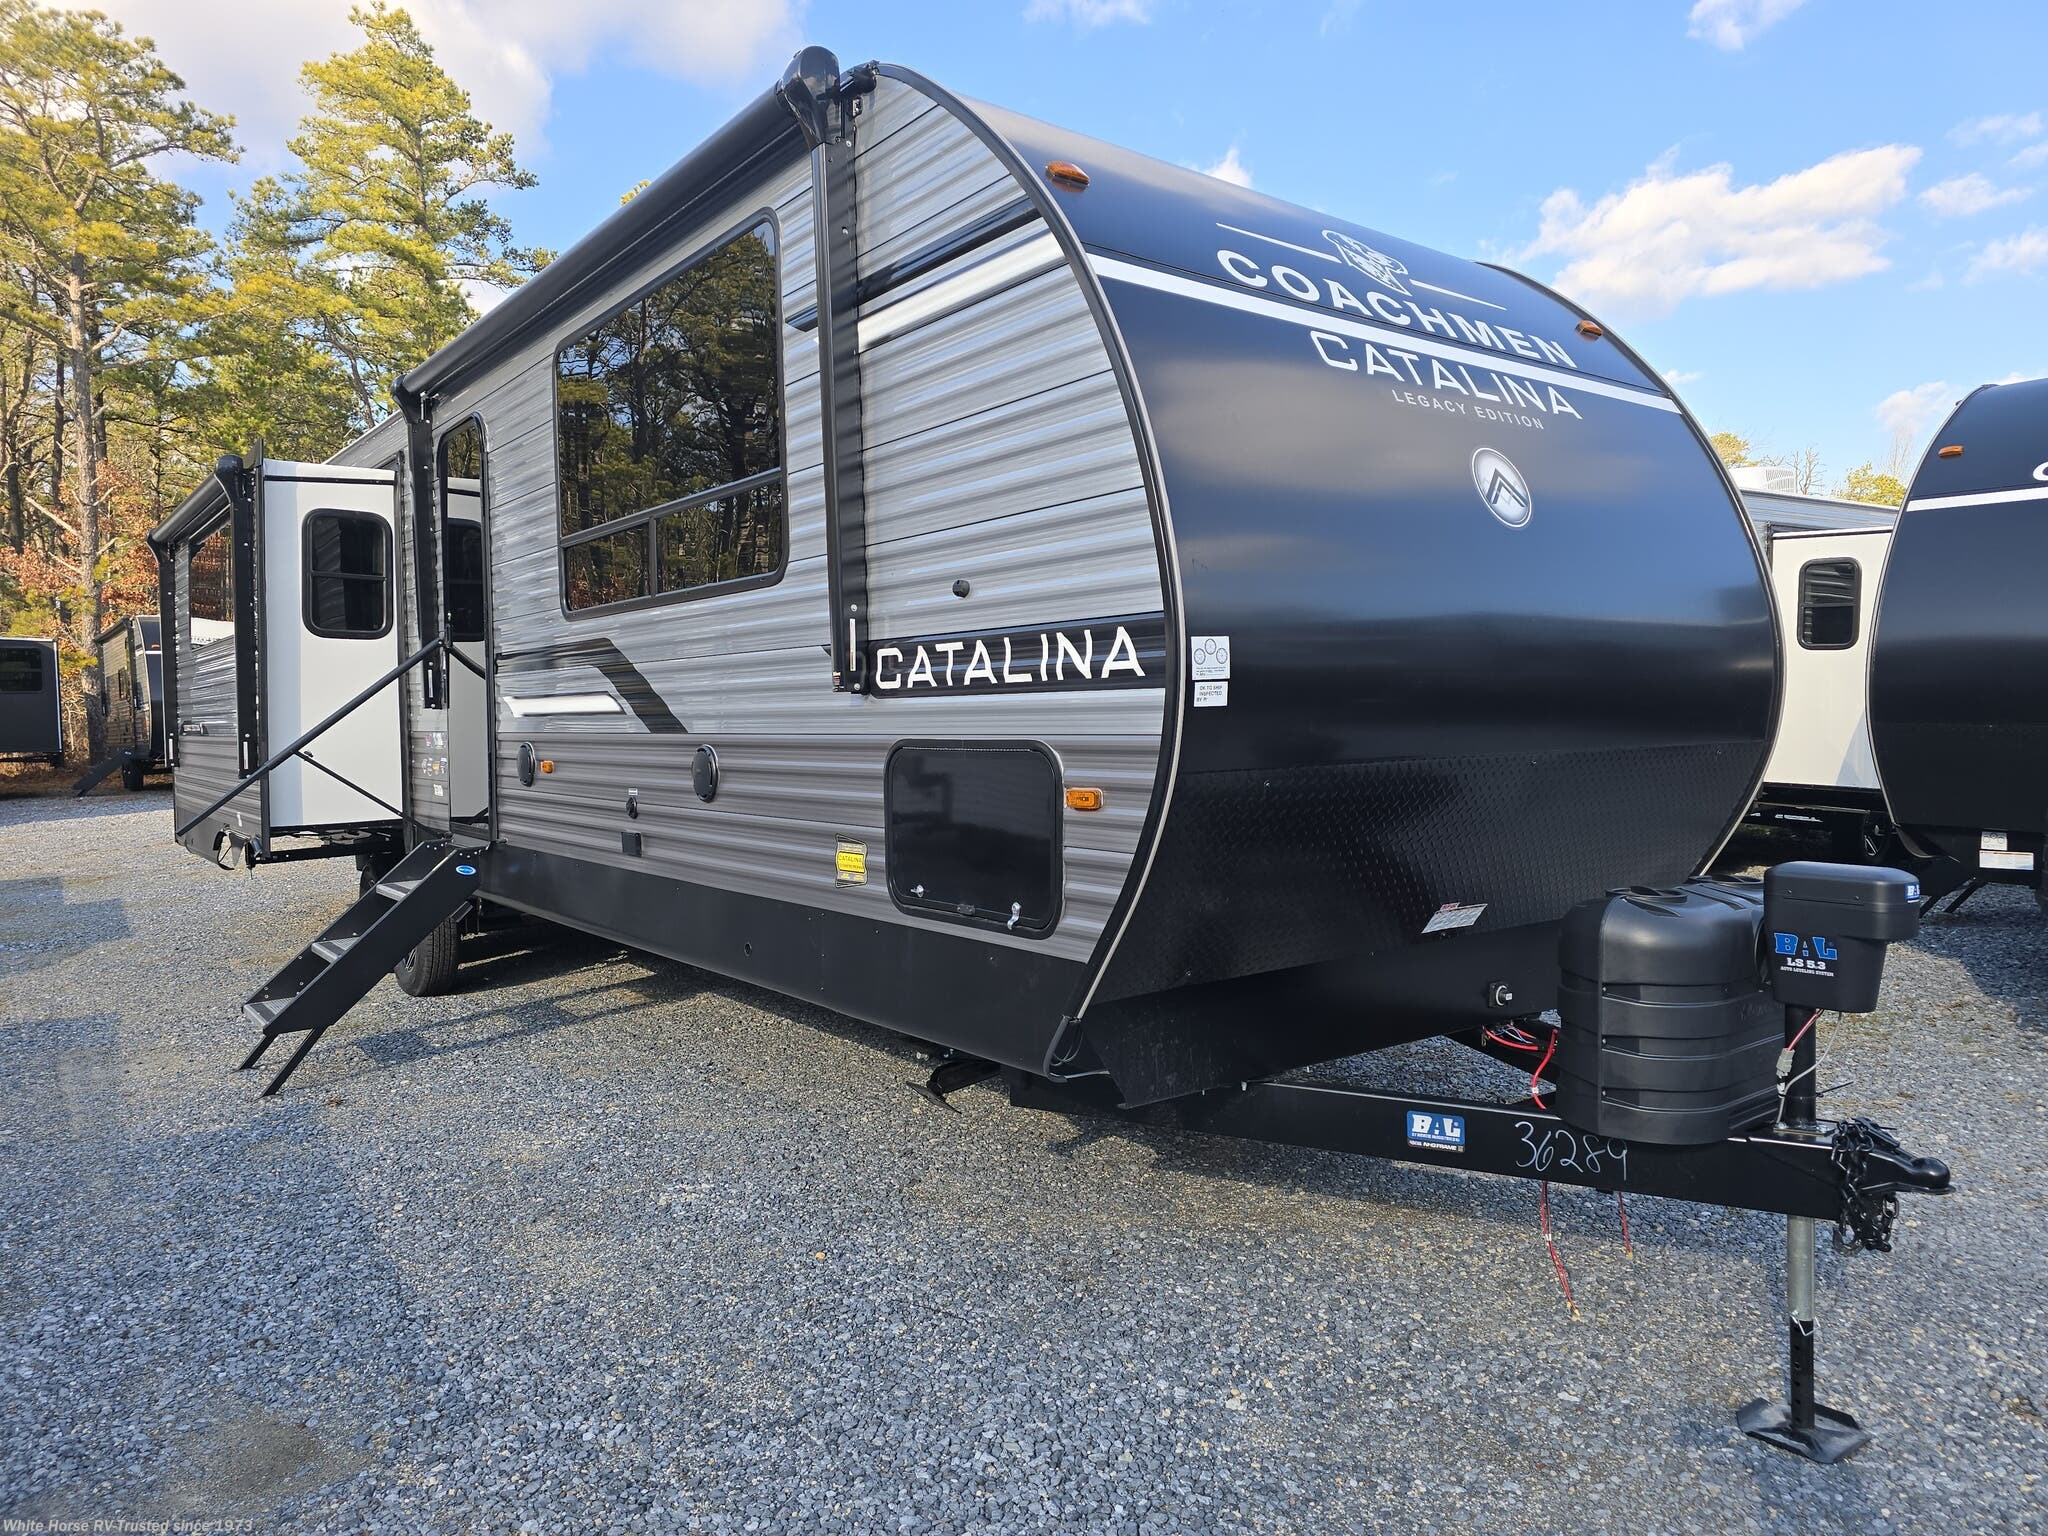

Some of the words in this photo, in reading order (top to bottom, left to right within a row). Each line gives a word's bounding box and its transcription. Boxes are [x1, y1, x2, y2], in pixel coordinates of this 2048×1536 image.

[1216, 249, 1578, 368] COACHMEN
[1310, 330, 1584, 420] CATALINA
[1392, 388, 1467, 416] LEGACY
[1477, 406, 1544, 430] EDITION
[875, 625, 1146, 689] CATALINA
[1774, 932, 1837, 960] BAL
[1787, 957, 1804, 967] LS
[1806, 960, 1826, 970] 5.3
[1412, 1114, 1461, 1137] BAL
[1515, 1121, 1628, 1181] 36289
